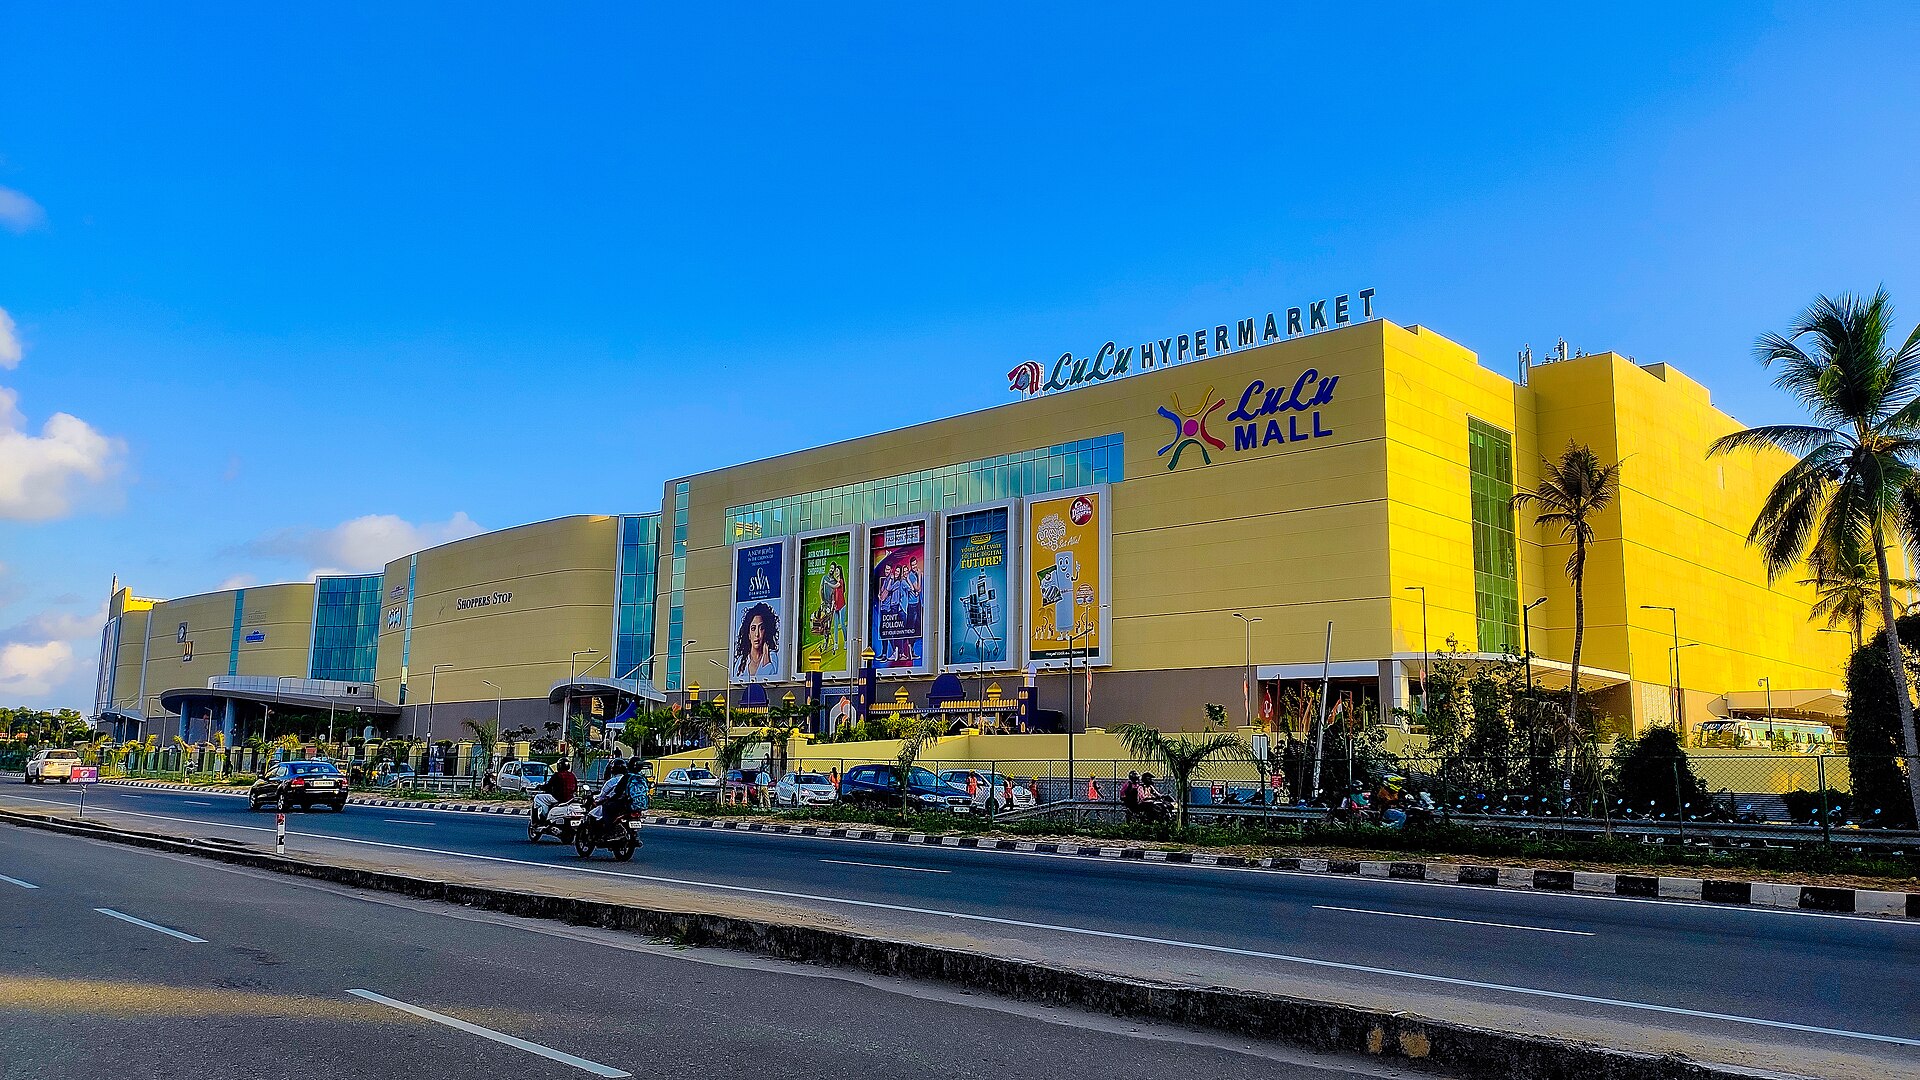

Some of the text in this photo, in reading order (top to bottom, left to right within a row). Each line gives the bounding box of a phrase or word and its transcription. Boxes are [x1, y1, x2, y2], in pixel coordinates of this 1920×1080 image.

[1141, 288, 1375, 369] HYPERMARKET
[1235, 411, 1332, 451] MALL
[981, 549, 1002, 557] DIGITAL
[961, 555, 1002, 569] FUTURE!
[492, 592, 513, 605] STOP
